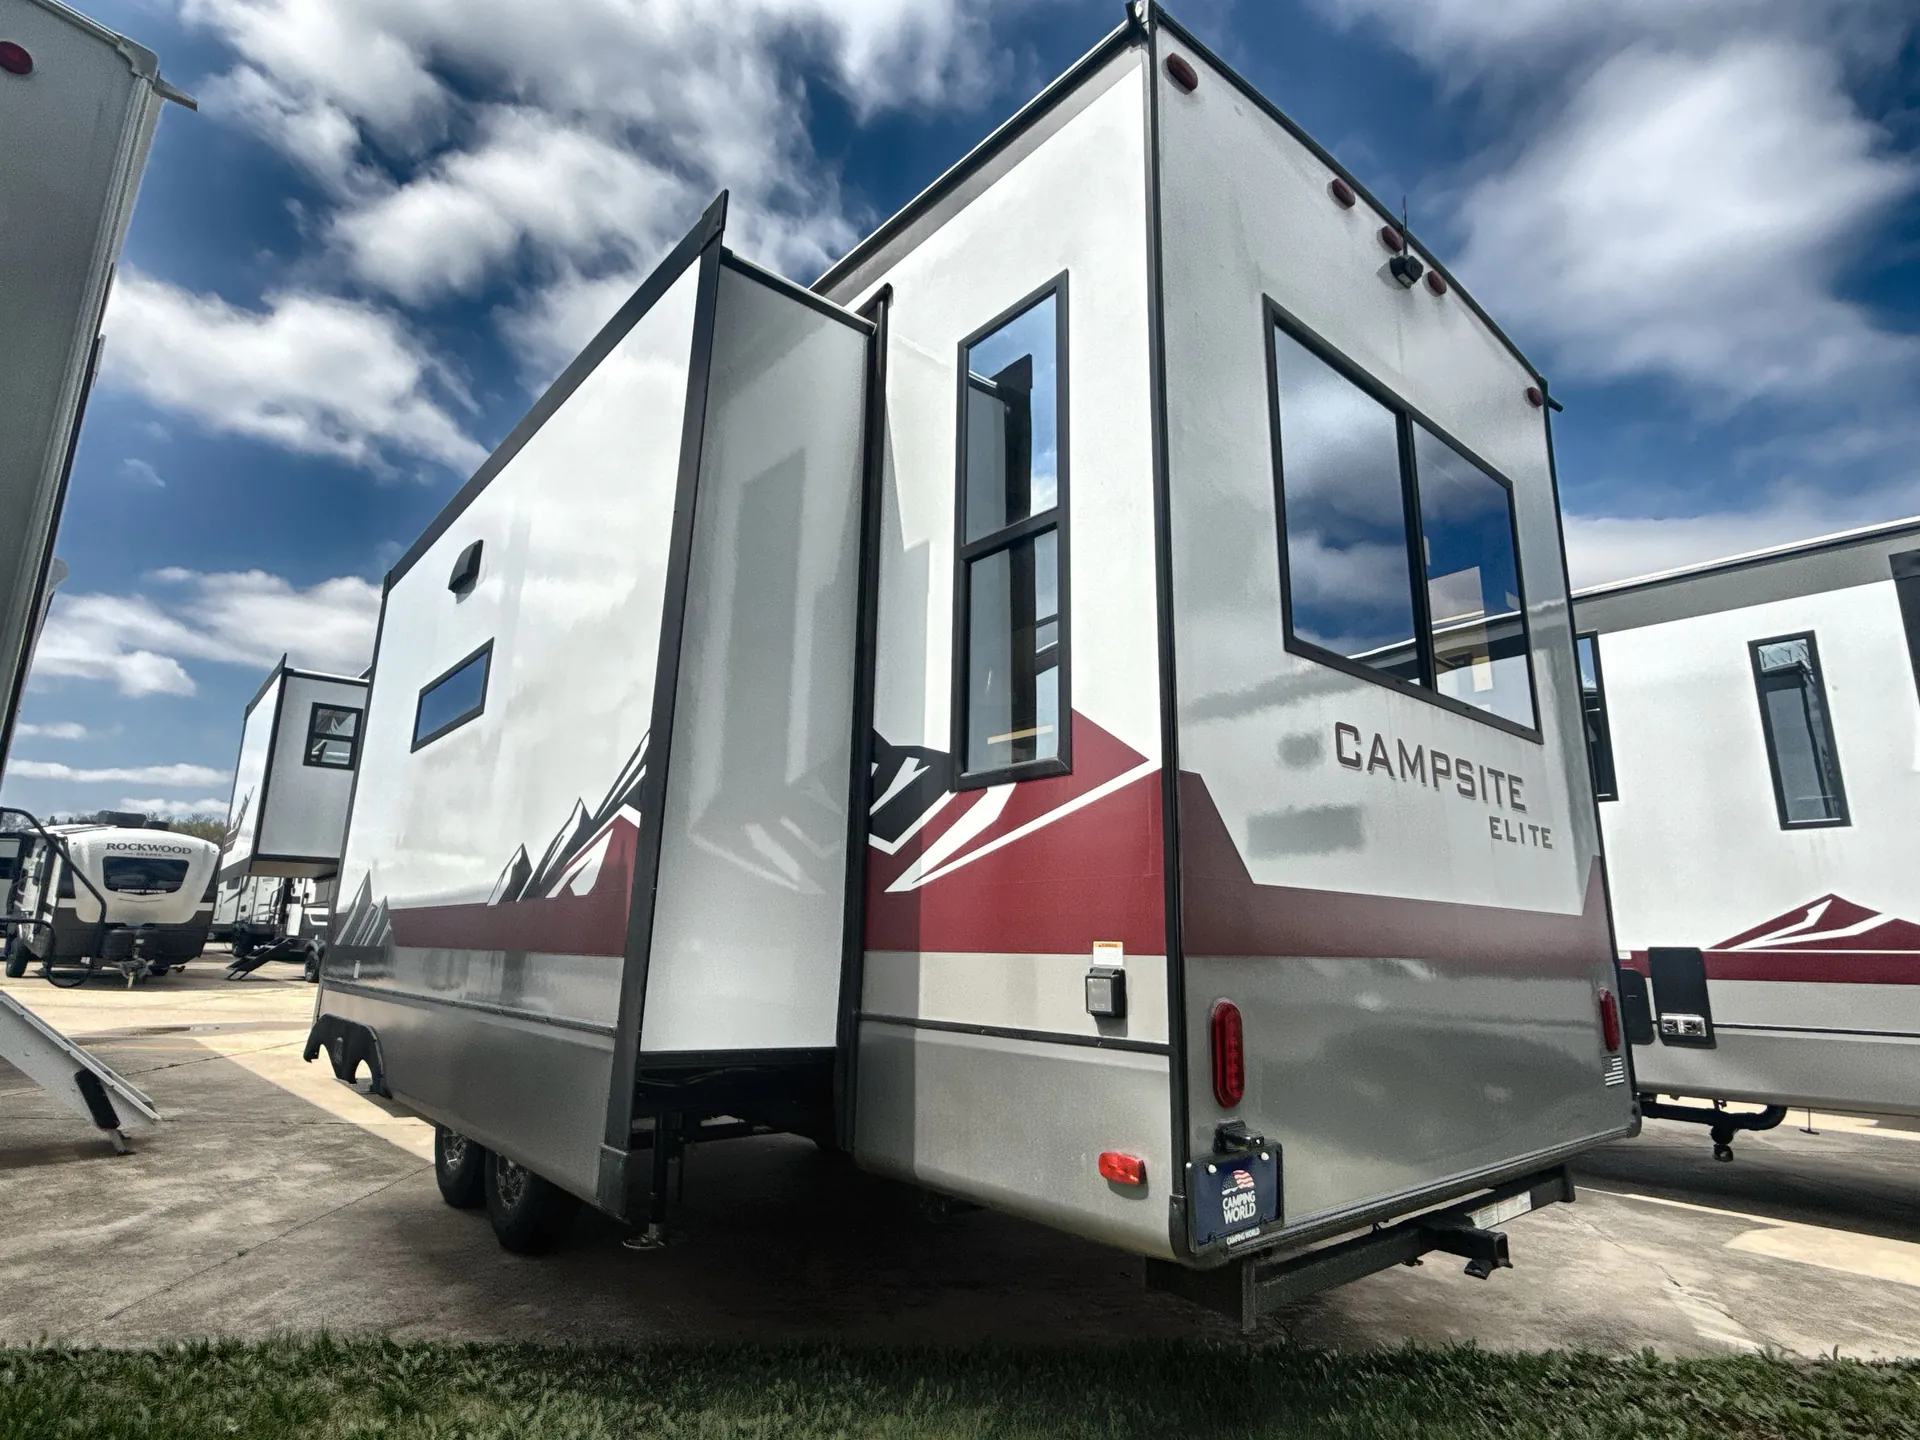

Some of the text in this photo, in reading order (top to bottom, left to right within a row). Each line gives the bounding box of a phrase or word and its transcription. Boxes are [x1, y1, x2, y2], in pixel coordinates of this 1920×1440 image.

[1334, 721, 1528, 813] CAMPSITE
[1488, 815, 1553, 849] ELITE
[105, 842, 192, 855] ROCKWOOD
[1222, 1190, 1256, 1211] CAMPING
[1223, 1203, 1256, 1225] WORLD
